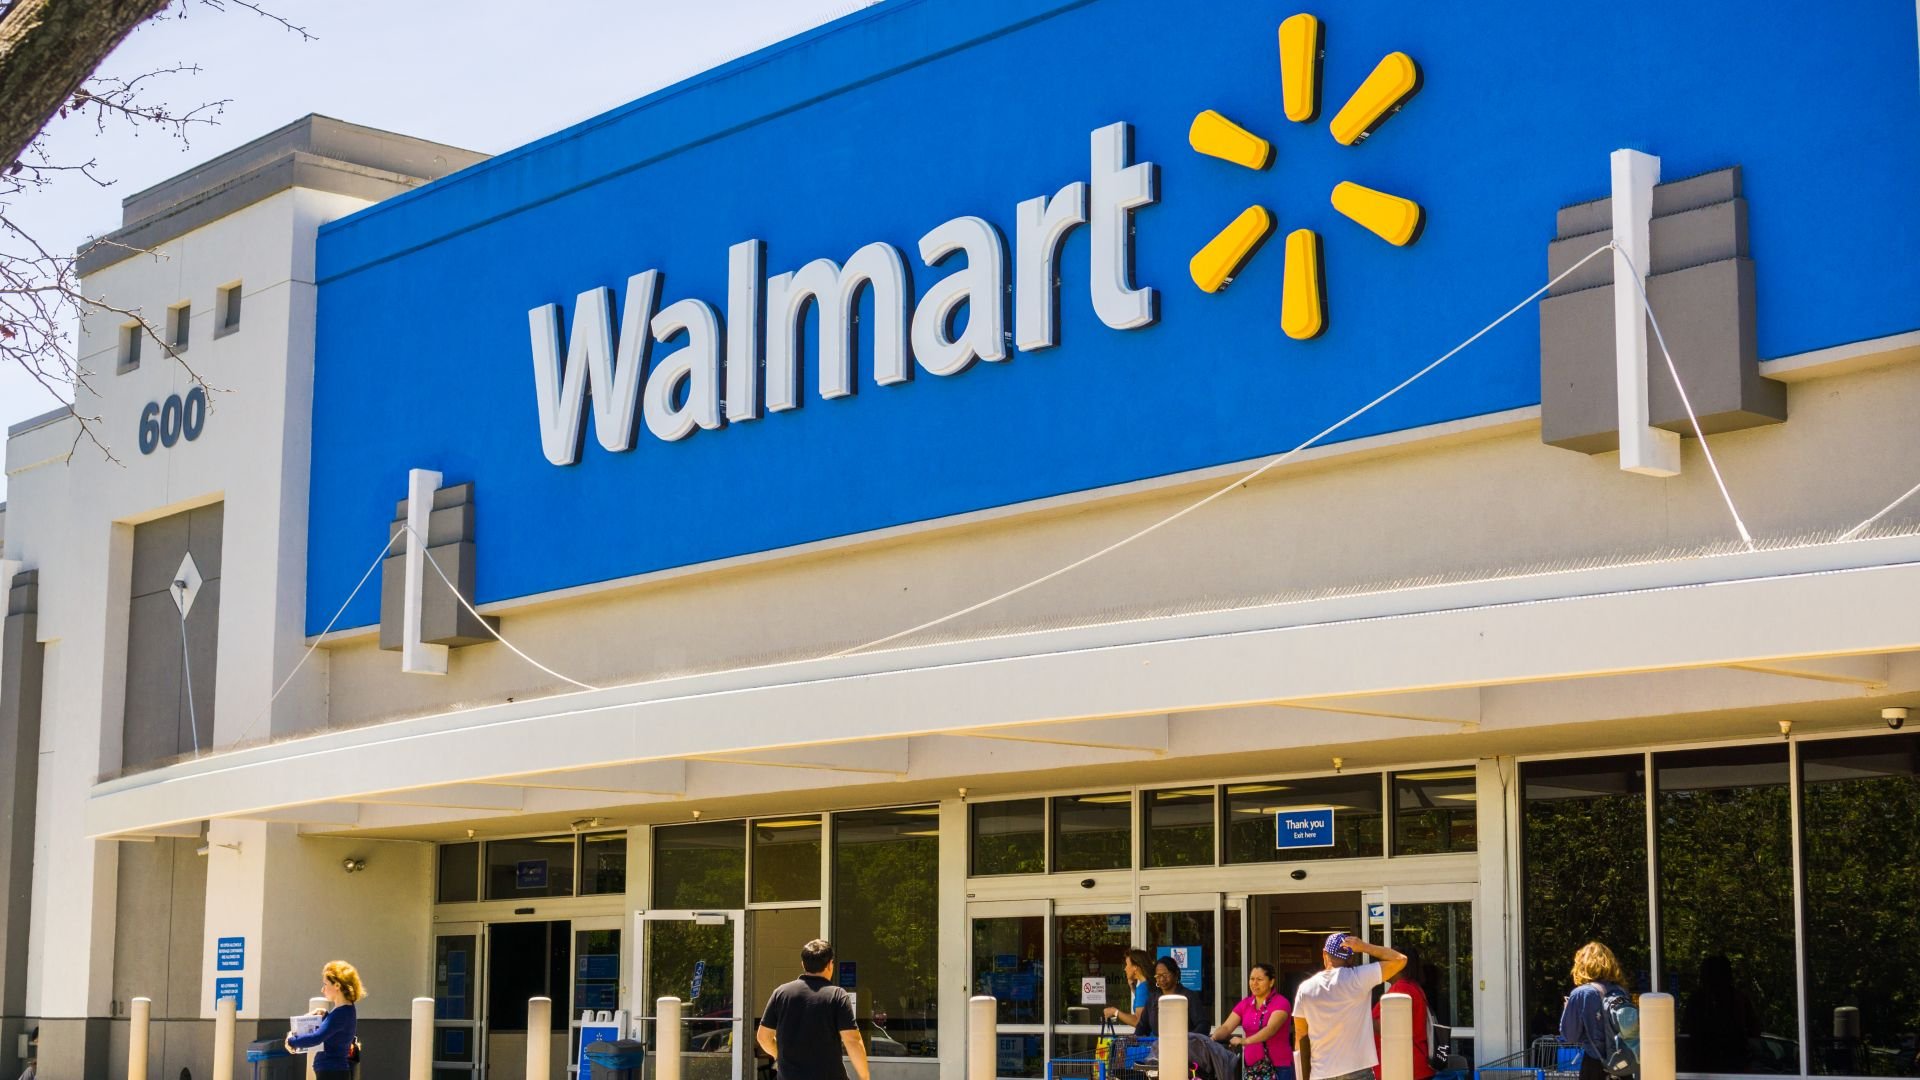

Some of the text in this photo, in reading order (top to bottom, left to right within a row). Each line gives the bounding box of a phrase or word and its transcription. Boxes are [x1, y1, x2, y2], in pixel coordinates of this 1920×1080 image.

[528, 120, 1160, 467] Walmart
[138, 386, 206, 455] 600
[1285, 819, 1324, 830] Thank you
